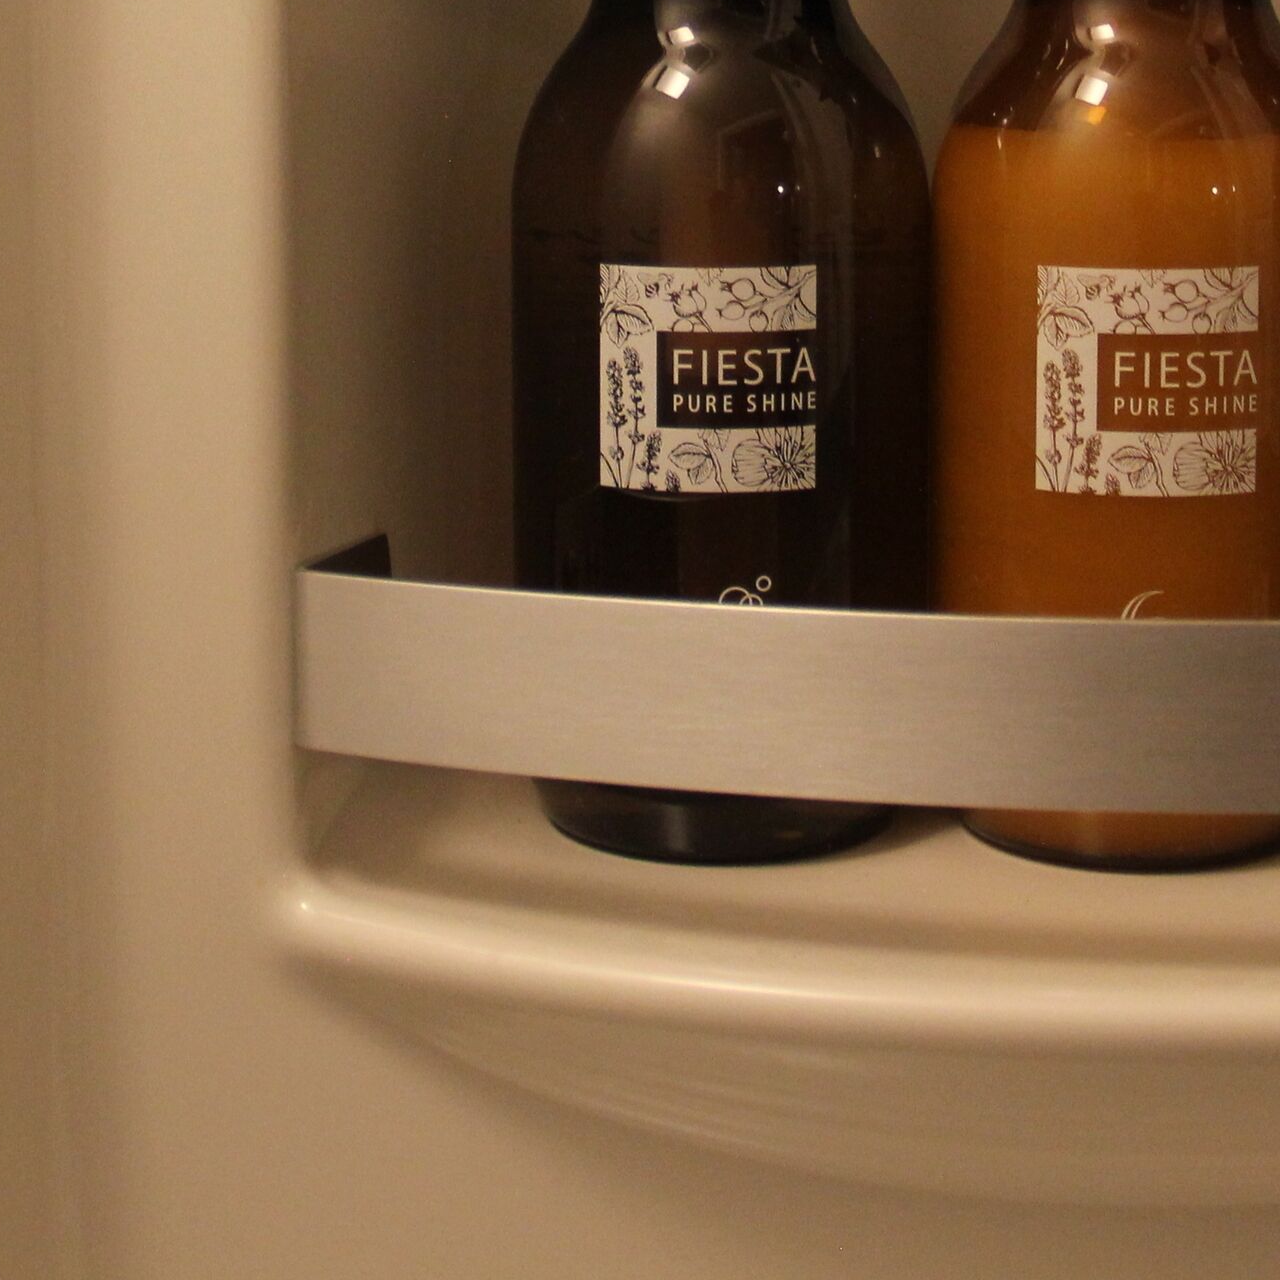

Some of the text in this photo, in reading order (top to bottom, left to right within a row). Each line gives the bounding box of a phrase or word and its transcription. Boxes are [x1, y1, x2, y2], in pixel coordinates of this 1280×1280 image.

[673, 347, 815, 386] FIESTA
[1114, 350, 1257, 388] FIESTA
[673, 391, 816, 413] PURE SHINE
[1114, 394, 1258, 416] PURE SHINE
